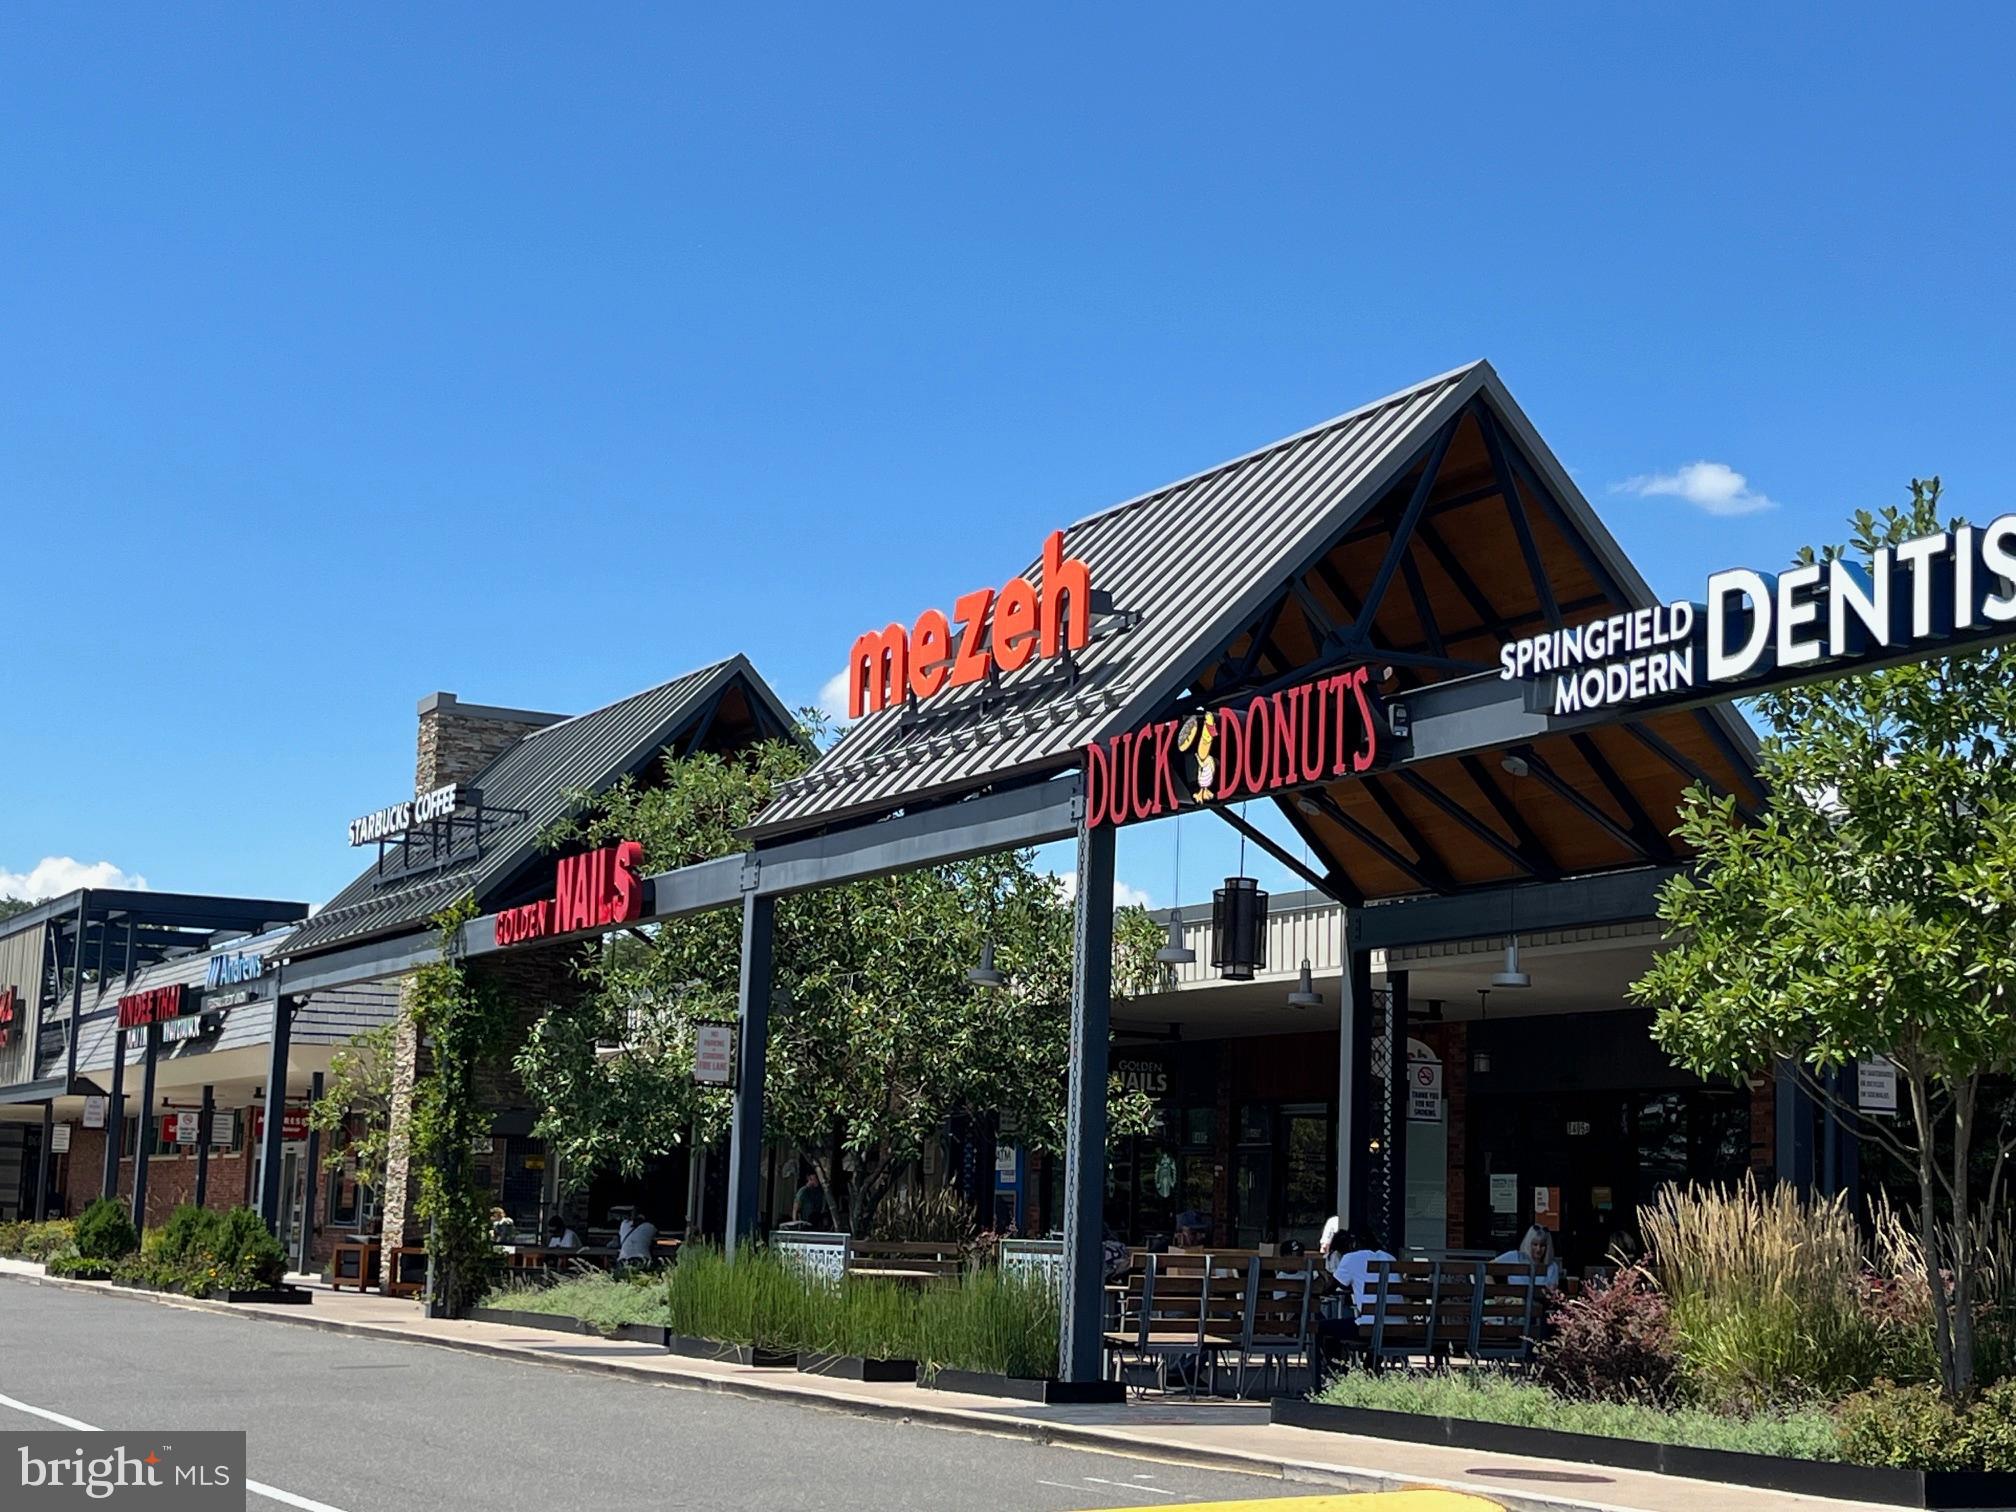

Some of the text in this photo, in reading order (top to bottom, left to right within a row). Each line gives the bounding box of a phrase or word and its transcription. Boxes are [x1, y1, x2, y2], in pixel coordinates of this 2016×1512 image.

[848, 530, 1091, 720] mezeh
[1707, 514, 2016, 682] DENTIS
[1499, 600, 1695, 681] SPRINGFIELD
[1553, 647, 1694, 716] MODERN
[1084, 665, 1377, 828] DUCK DONUTS
[348, 782, 458, 846] STARBUCKS COFFEE
[494, 841, 643, 946] GOLDEN NAILS
[220, 952, 263, 986] Andrews
[1119, 1060, 1163, 1072] GOLDEN
